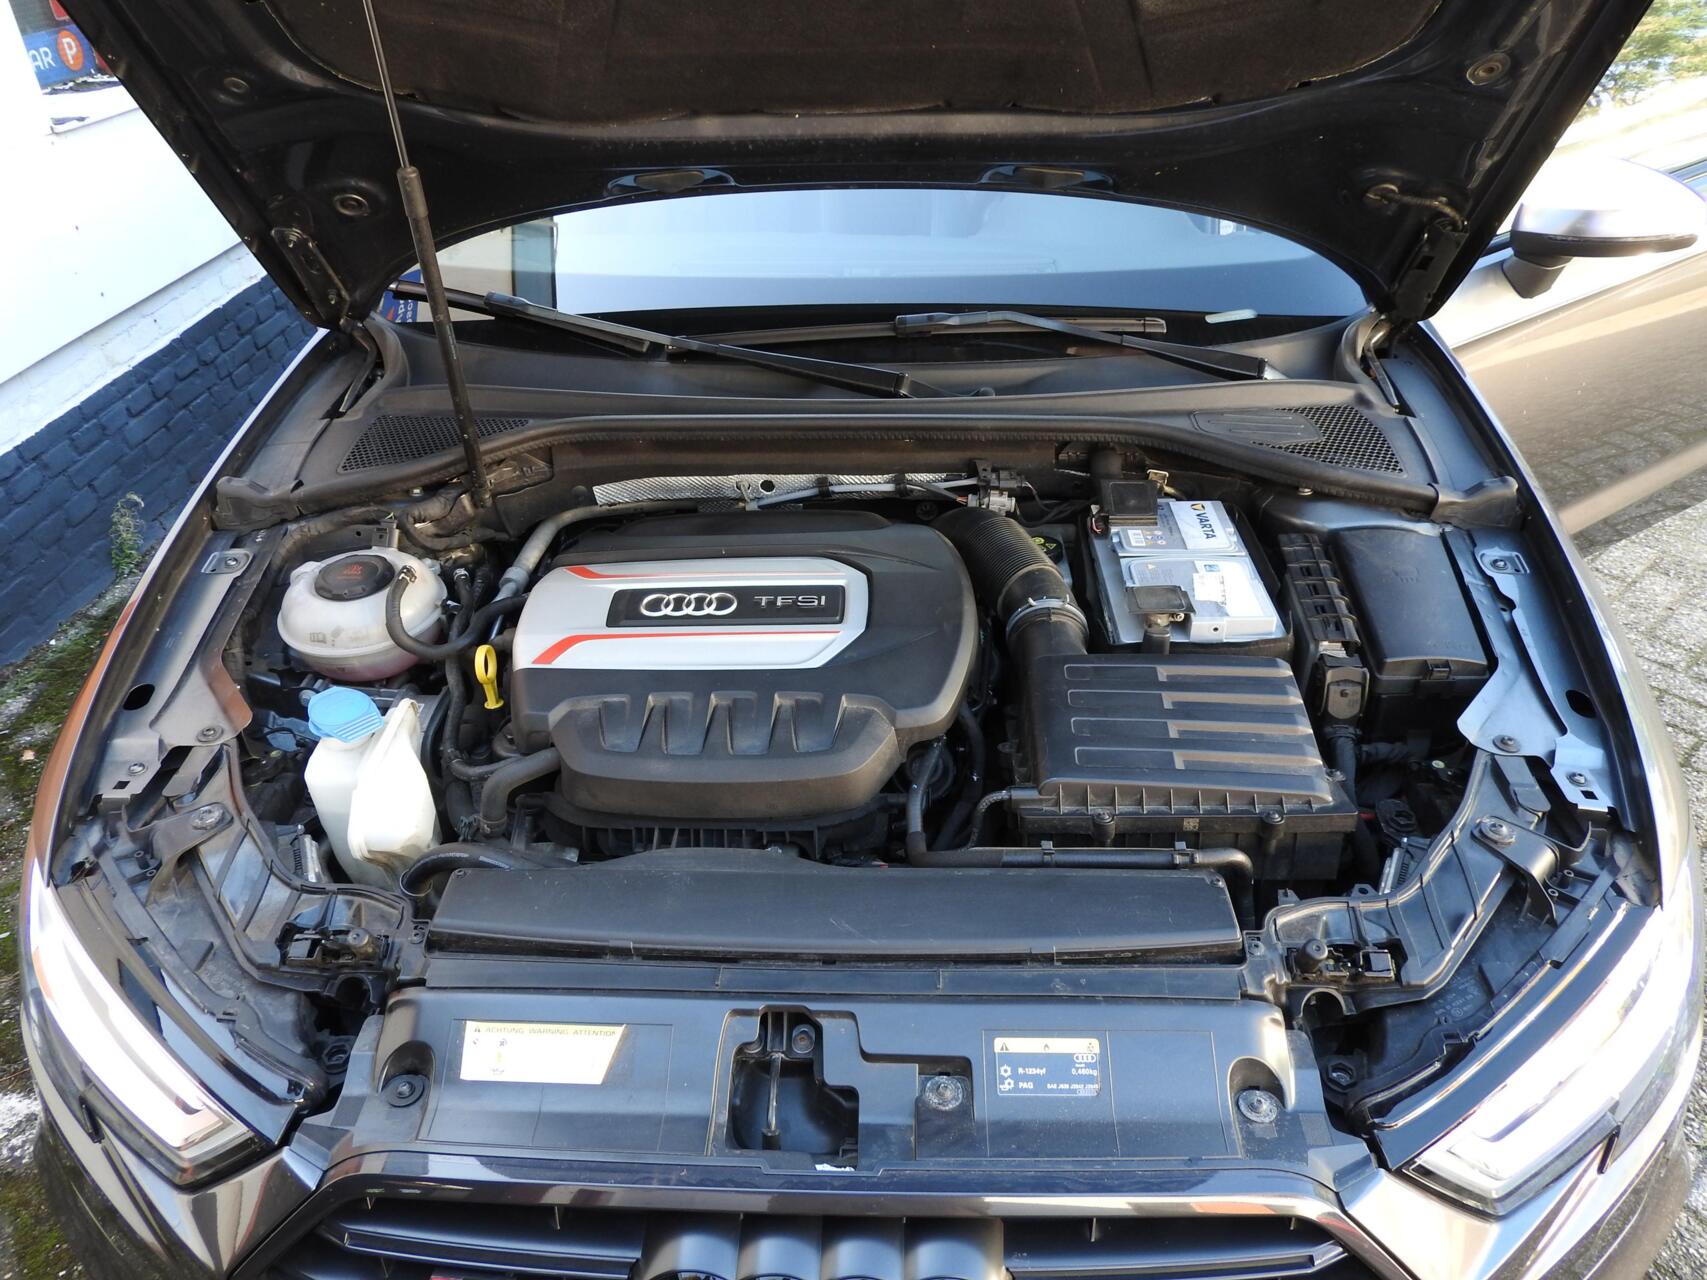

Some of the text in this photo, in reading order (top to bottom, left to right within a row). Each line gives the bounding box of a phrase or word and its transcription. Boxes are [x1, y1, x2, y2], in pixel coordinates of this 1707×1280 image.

[1195, 512, 1217, 539] VARTA
[754, 595, 826, 607] TFSI
[485, 1027, 524, 1035] ACHTUNG
[529, 1028, 569, 1036] WARNING
